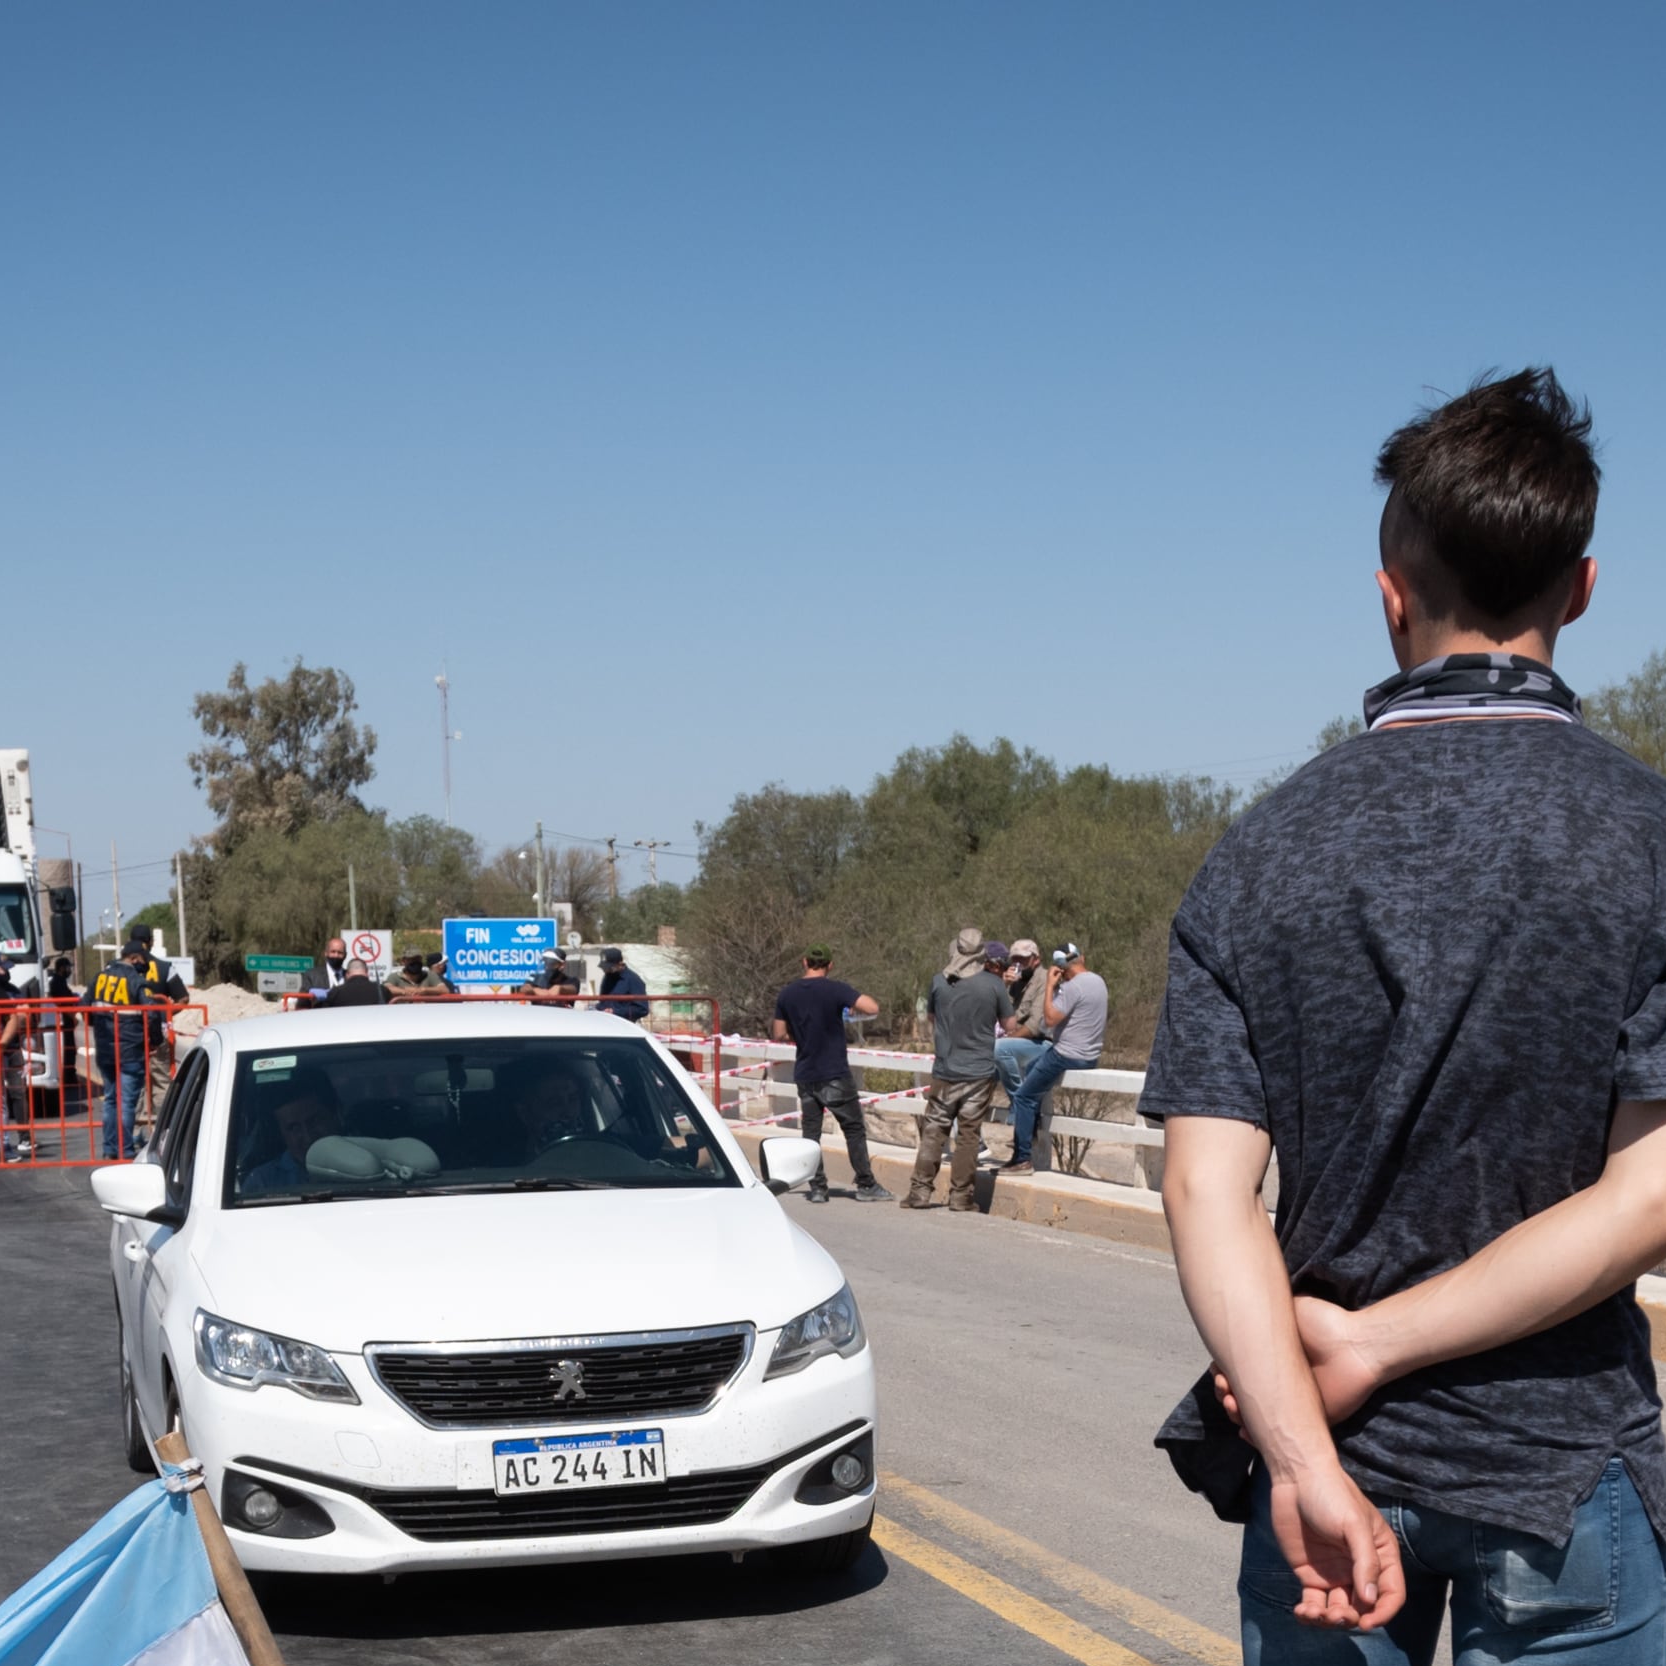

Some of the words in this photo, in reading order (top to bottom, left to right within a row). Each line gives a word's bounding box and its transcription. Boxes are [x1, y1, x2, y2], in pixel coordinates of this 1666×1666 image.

[465, 927, 491, 944] FIN
[455, 949, 545, 965] CONCESION
[95, 973, 130, 1005] PFA
[578, 1440, 618, 1449] ARGENTINA
[505, 1457, 540, 1488] AC
[552, 1452, 608, 1484] 244
[622, 1447, 657, 1478] IN
